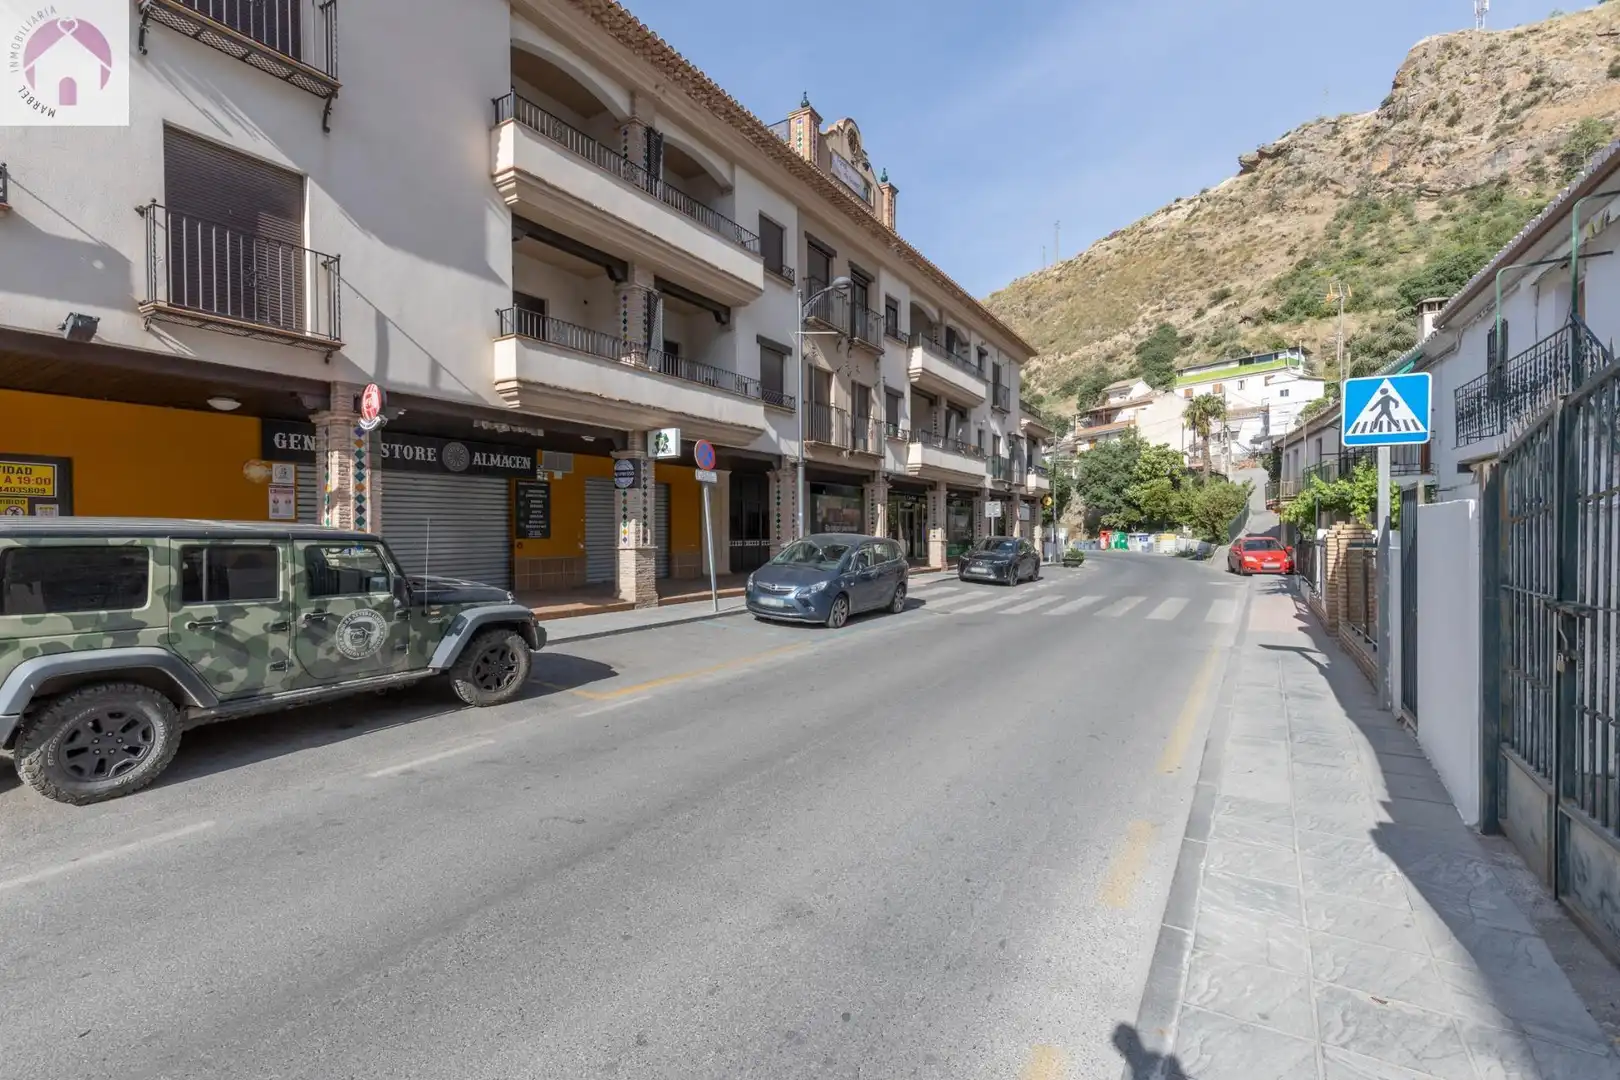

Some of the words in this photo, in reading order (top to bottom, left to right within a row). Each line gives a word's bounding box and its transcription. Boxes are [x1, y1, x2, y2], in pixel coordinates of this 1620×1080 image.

[380, 443, 437, 462] STORE
[472, 452, 531, 469] ALMACEN
[0, 465, 33, 475] IDAD
[17, 476, 51, 486] 19:00
